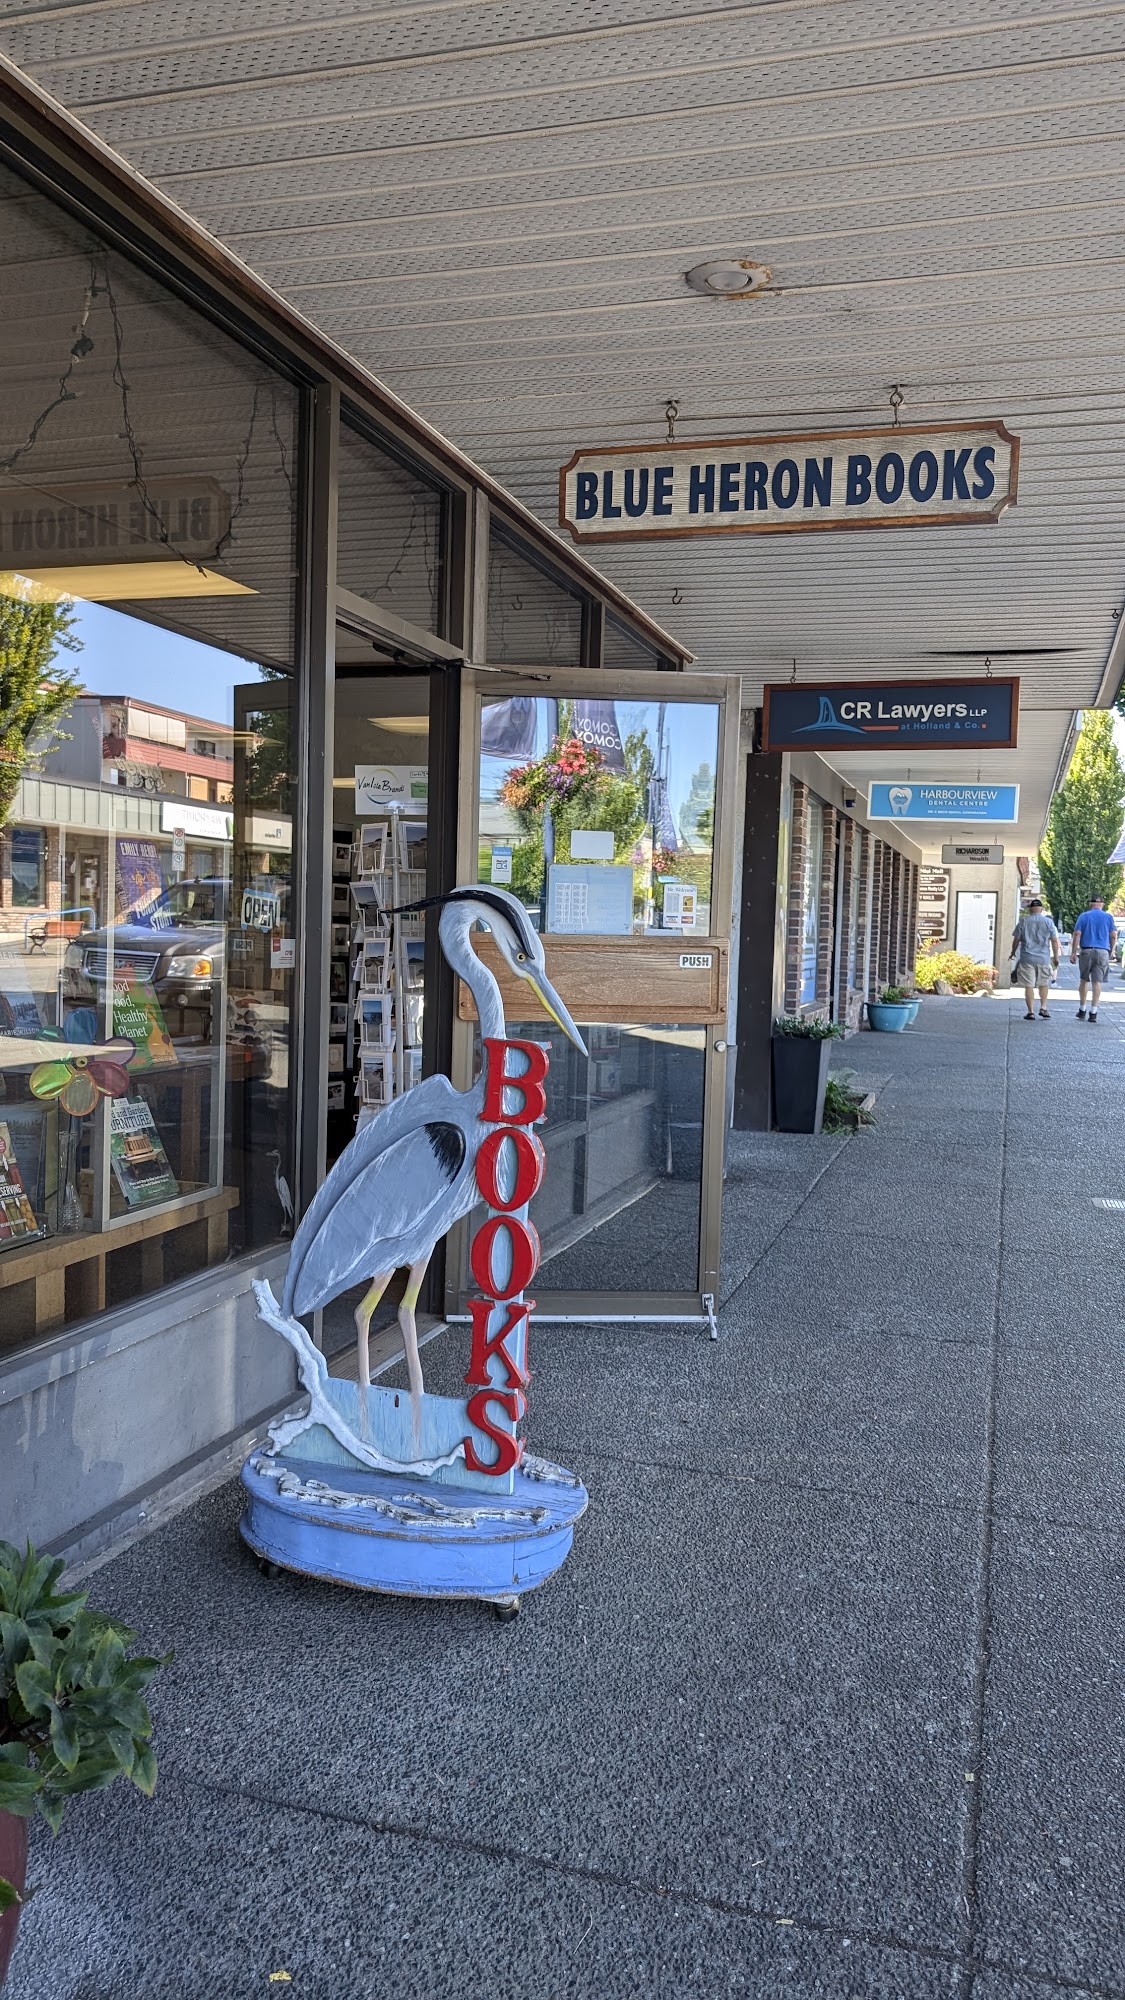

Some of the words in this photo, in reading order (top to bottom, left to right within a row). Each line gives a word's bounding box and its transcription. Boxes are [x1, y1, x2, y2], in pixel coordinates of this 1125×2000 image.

[576, 467, 674, 520] BLUE
[688, 456, 833, 513] HERON
[845, 446, 996, 506] BOOKS
[840, 701, 872, 720] CR
[878, 702, 968, 723] Lawyers
[969, 709, 988, 717] LLP
[901, 723, 911, 731] at
[913, 721, 950, 730] Holland
[954, 721, 961, 729] &
[920, 789, 998, 800] HARBOURVIEW
[119, 842, 139, 857] EMILY
[955, 847, 990, 855] RICHARDSON
[244, 896, 278, 927] OPEN
[150, 908, 173, 933] STORY
[682, 956, 709, 967] PUSH
[113, 980, 129, 992] ood
[114, 995, 135, 1008] ood,
[114, 1008, 149, 1024] Healthy
[118, 1025, 148, 1038] Planet
[111, 1113, 152, 1131] URNITURE
[0, 1183, 22, 1197] SERVING
[464, 1037, 551, 1476] BOOKS
